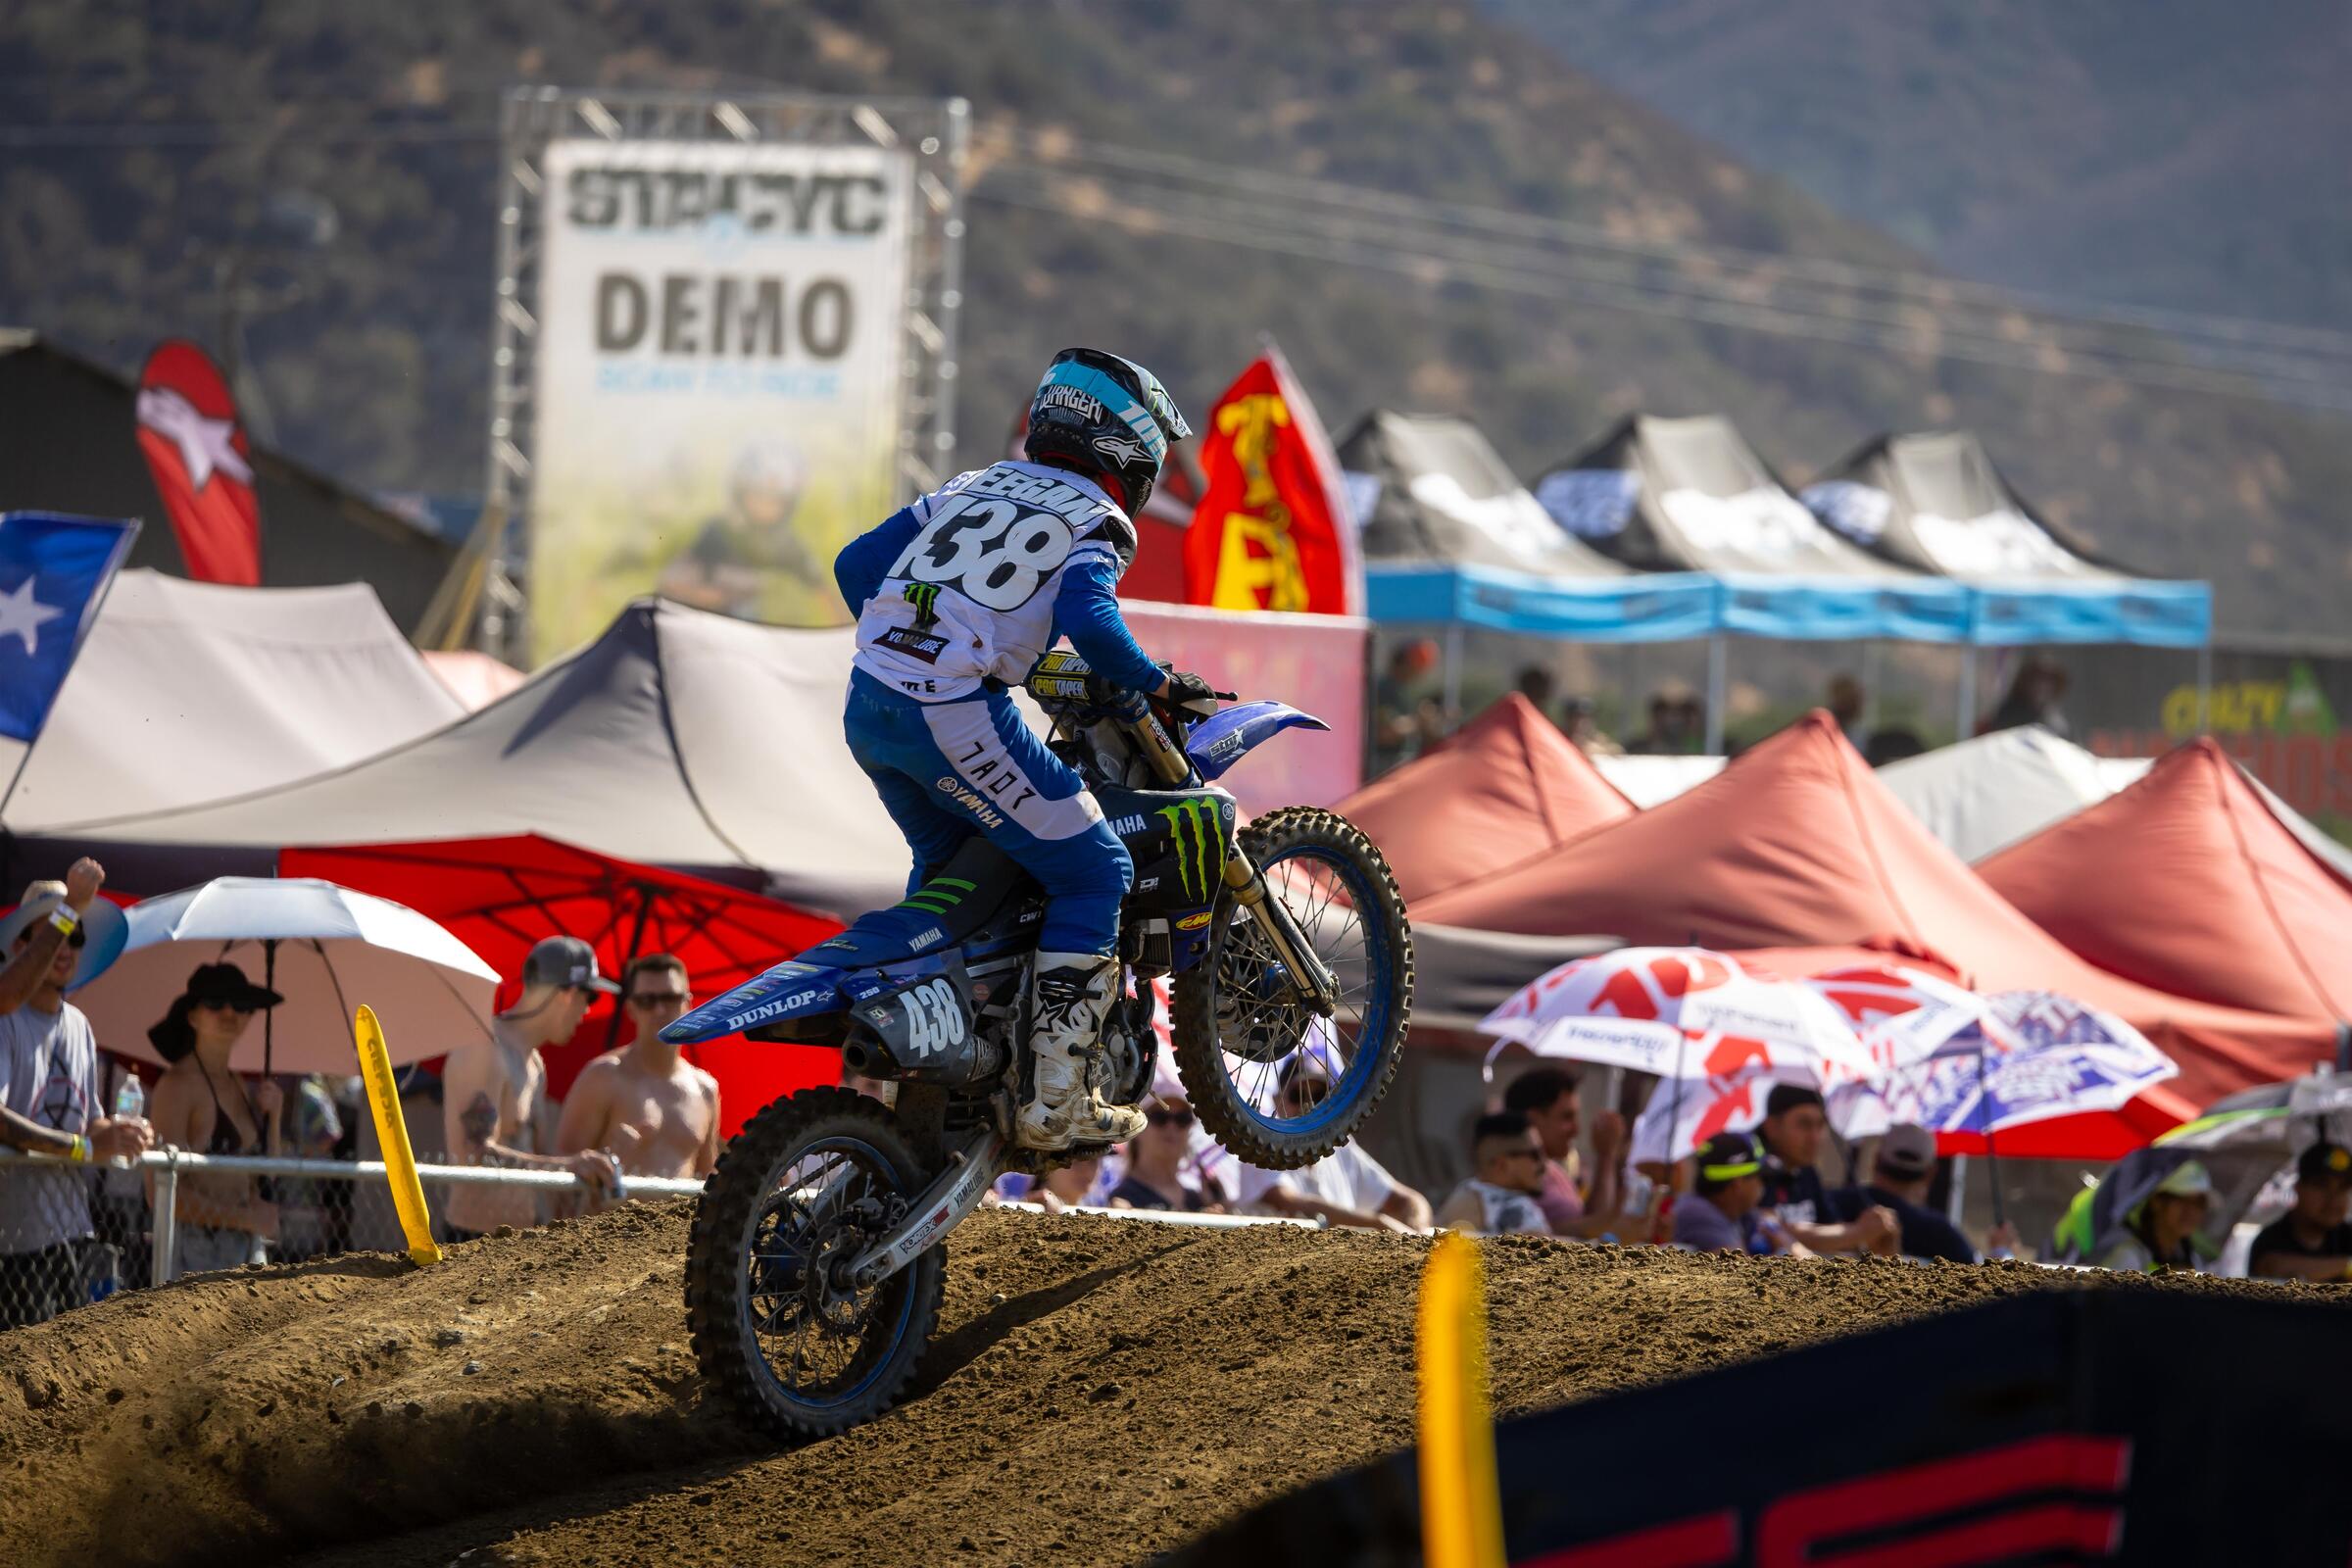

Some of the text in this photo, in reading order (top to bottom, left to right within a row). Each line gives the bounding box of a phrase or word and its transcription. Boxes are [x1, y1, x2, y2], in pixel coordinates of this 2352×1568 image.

[596, 272, 855, 360] DEMO
[957, 466, 1111, 528] EEGAN
[952, 787, 1004, 829] YAMAHA
[907, 927, 943, 953] YAMAHA
[727, 990, 816, 1030] DUNLOP
[858, 986, 881, 1000] 250
[898, 977, 964, 1058] 438
